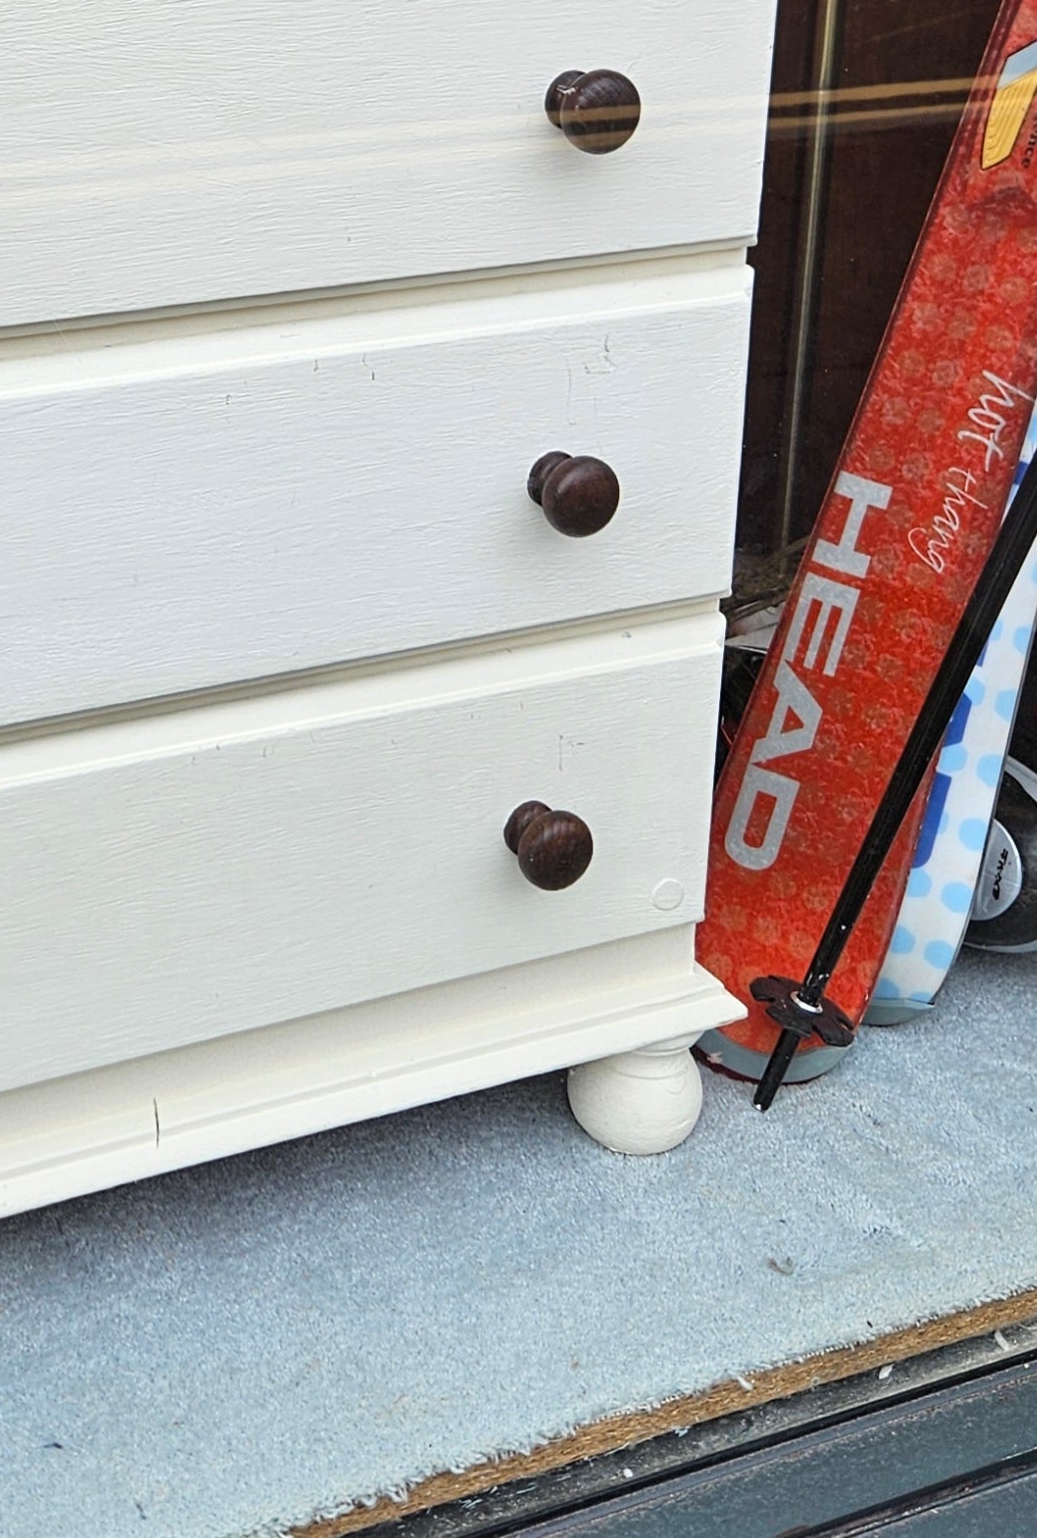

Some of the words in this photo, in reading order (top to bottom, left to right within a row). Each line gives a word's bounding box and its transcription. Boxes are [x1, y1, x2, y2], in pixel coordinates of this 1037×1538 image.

[957, 369, 1036, 472] hot
[908, 466, 989, 574] thang
[724, 470, 894, 871] HEAD
